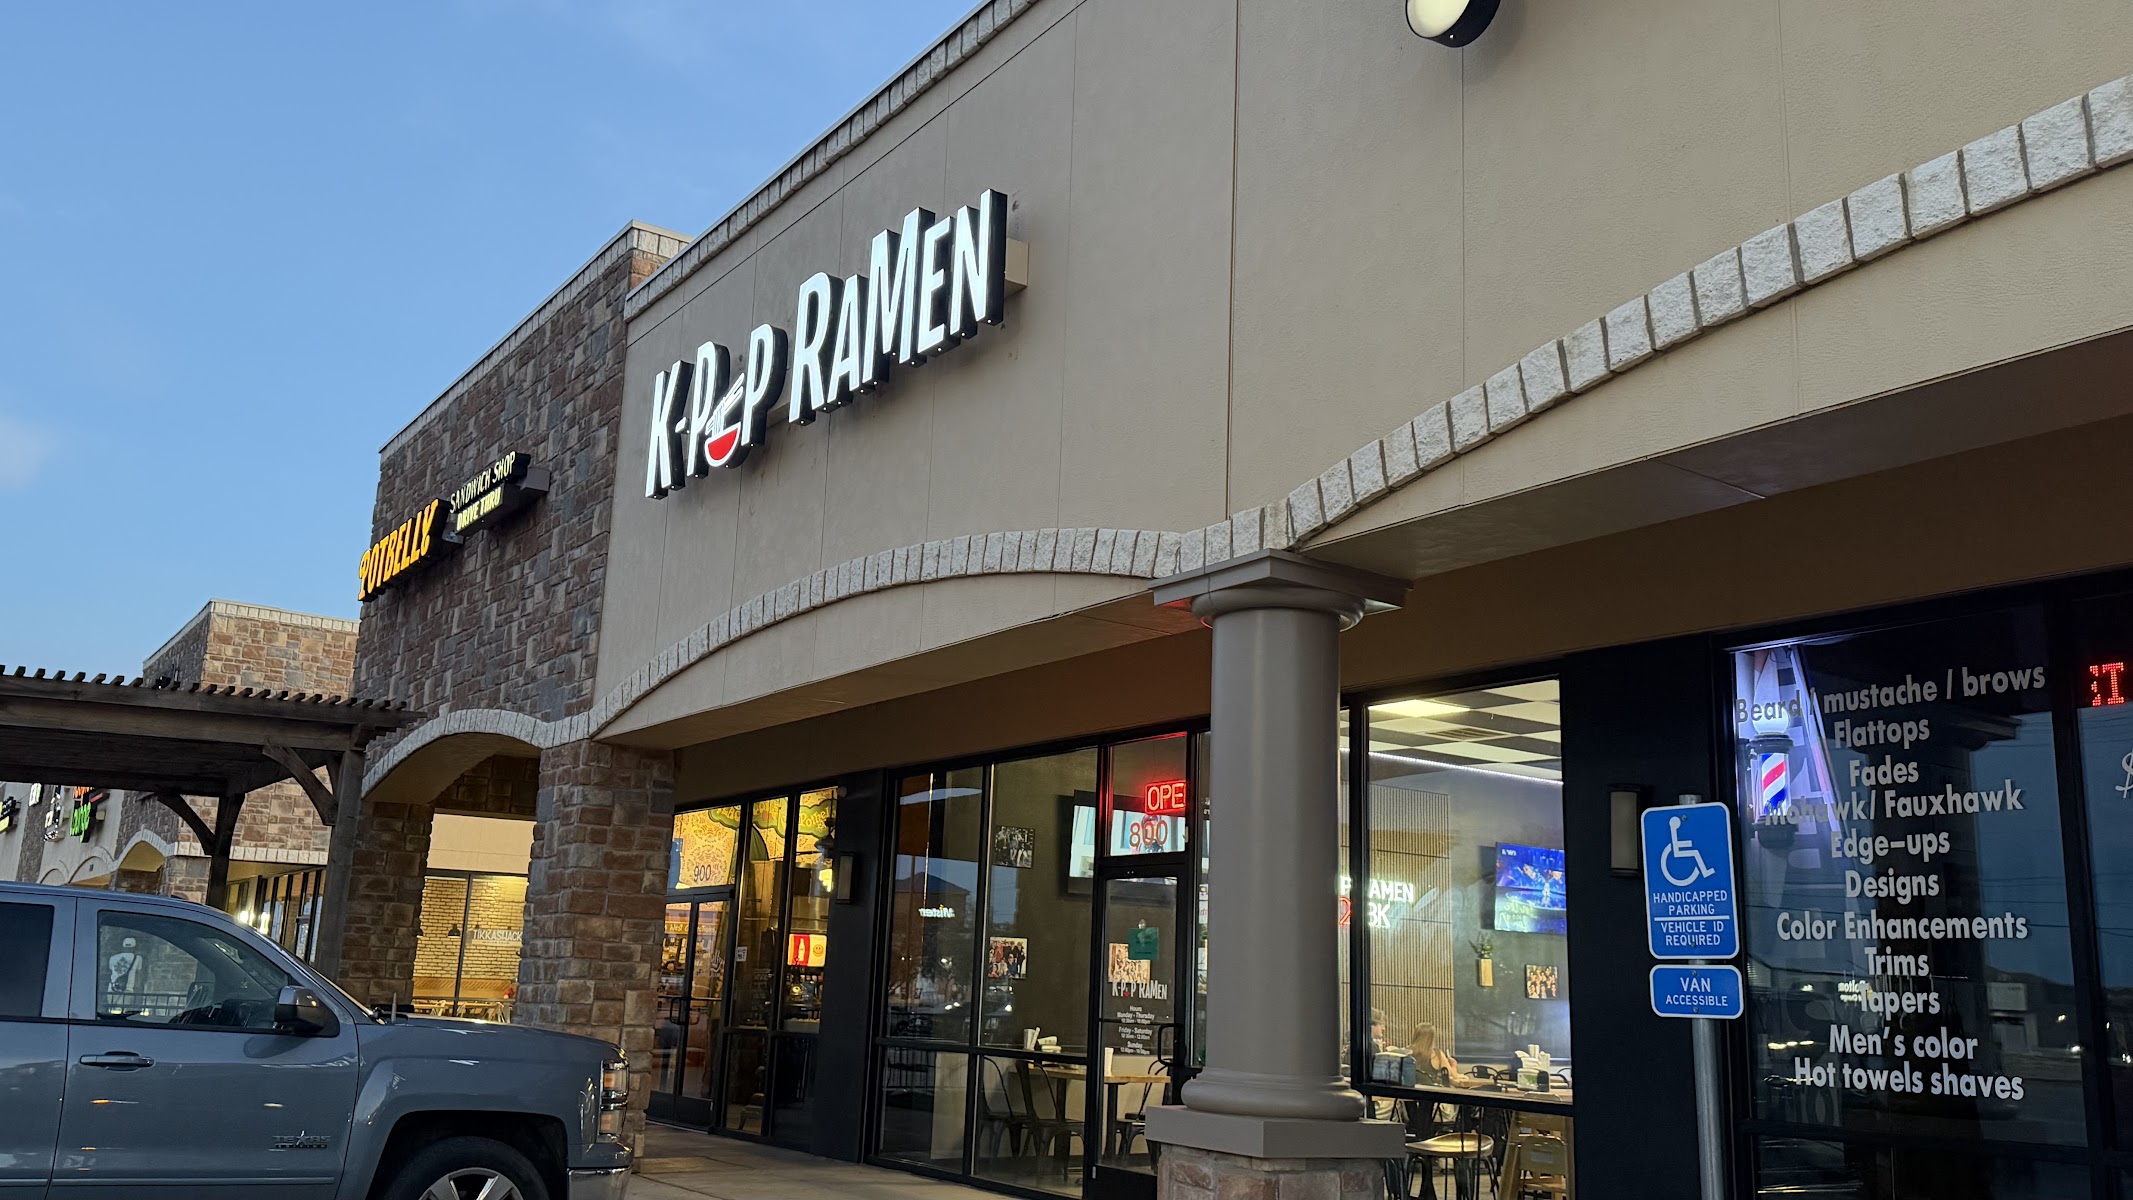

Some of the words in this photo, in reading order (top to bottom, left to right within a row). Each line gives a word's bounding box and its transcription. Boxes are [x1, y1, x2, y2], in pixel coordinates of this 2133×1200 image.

[450, 468, 491, 513] SANDWICH
[492, 451, 516, 483] SHOP
[456, 504, 479, 531] DRIVE
[480, 487, 502, 516] THRU
[358, 498, 439, 600] POTBELLY
[1736, 688, 1802, 723] Beard
[1824, 674, 1938, 715] mustache
[1962, 665, 2046, 698] brows
[1834, 717, 1930, 750] Flattops
[1849, 755, 1919, 788] Fades
[1147, 783, 1185, 811] OPE
[1885, 779, 2024, 819] Fauxhawk
[1129, 820, 1168, 848] 800
[1831, 831, 1951, 865] Edge-ups
[693, 864, 712, 883] 900
[1845, 867, 1940, 905] Designs
[1368, 878, 1415, 903] AMEN
[1653, 889, 1728, 904] HANDICAPPED
[1668, 904, 1715, 916] PARKING
[1777, 910, 1837, 942] Color
[1845, 909, 2028, 941] Enhancements
[1661, 921, 1706, 934] VEHICLE
[1713, 921, 1724, 932] ID
[1665, 934, 1721, 946] REQUIRED
[1864, 946, 1930, 977] Trims
[1665, 995, 1728, 1007] ACCESSIBLE
[1680, 977, 1711, 992] VAN
[1858, 983, 1940, 1021] Tapers
[1913, 1026, 1978, 1060] color
[1794, 1057, 1837, 1088] Hot
[1843, 1061, 1923, 1095] towels
[1931, 1063, 2025, 1101] shaves
